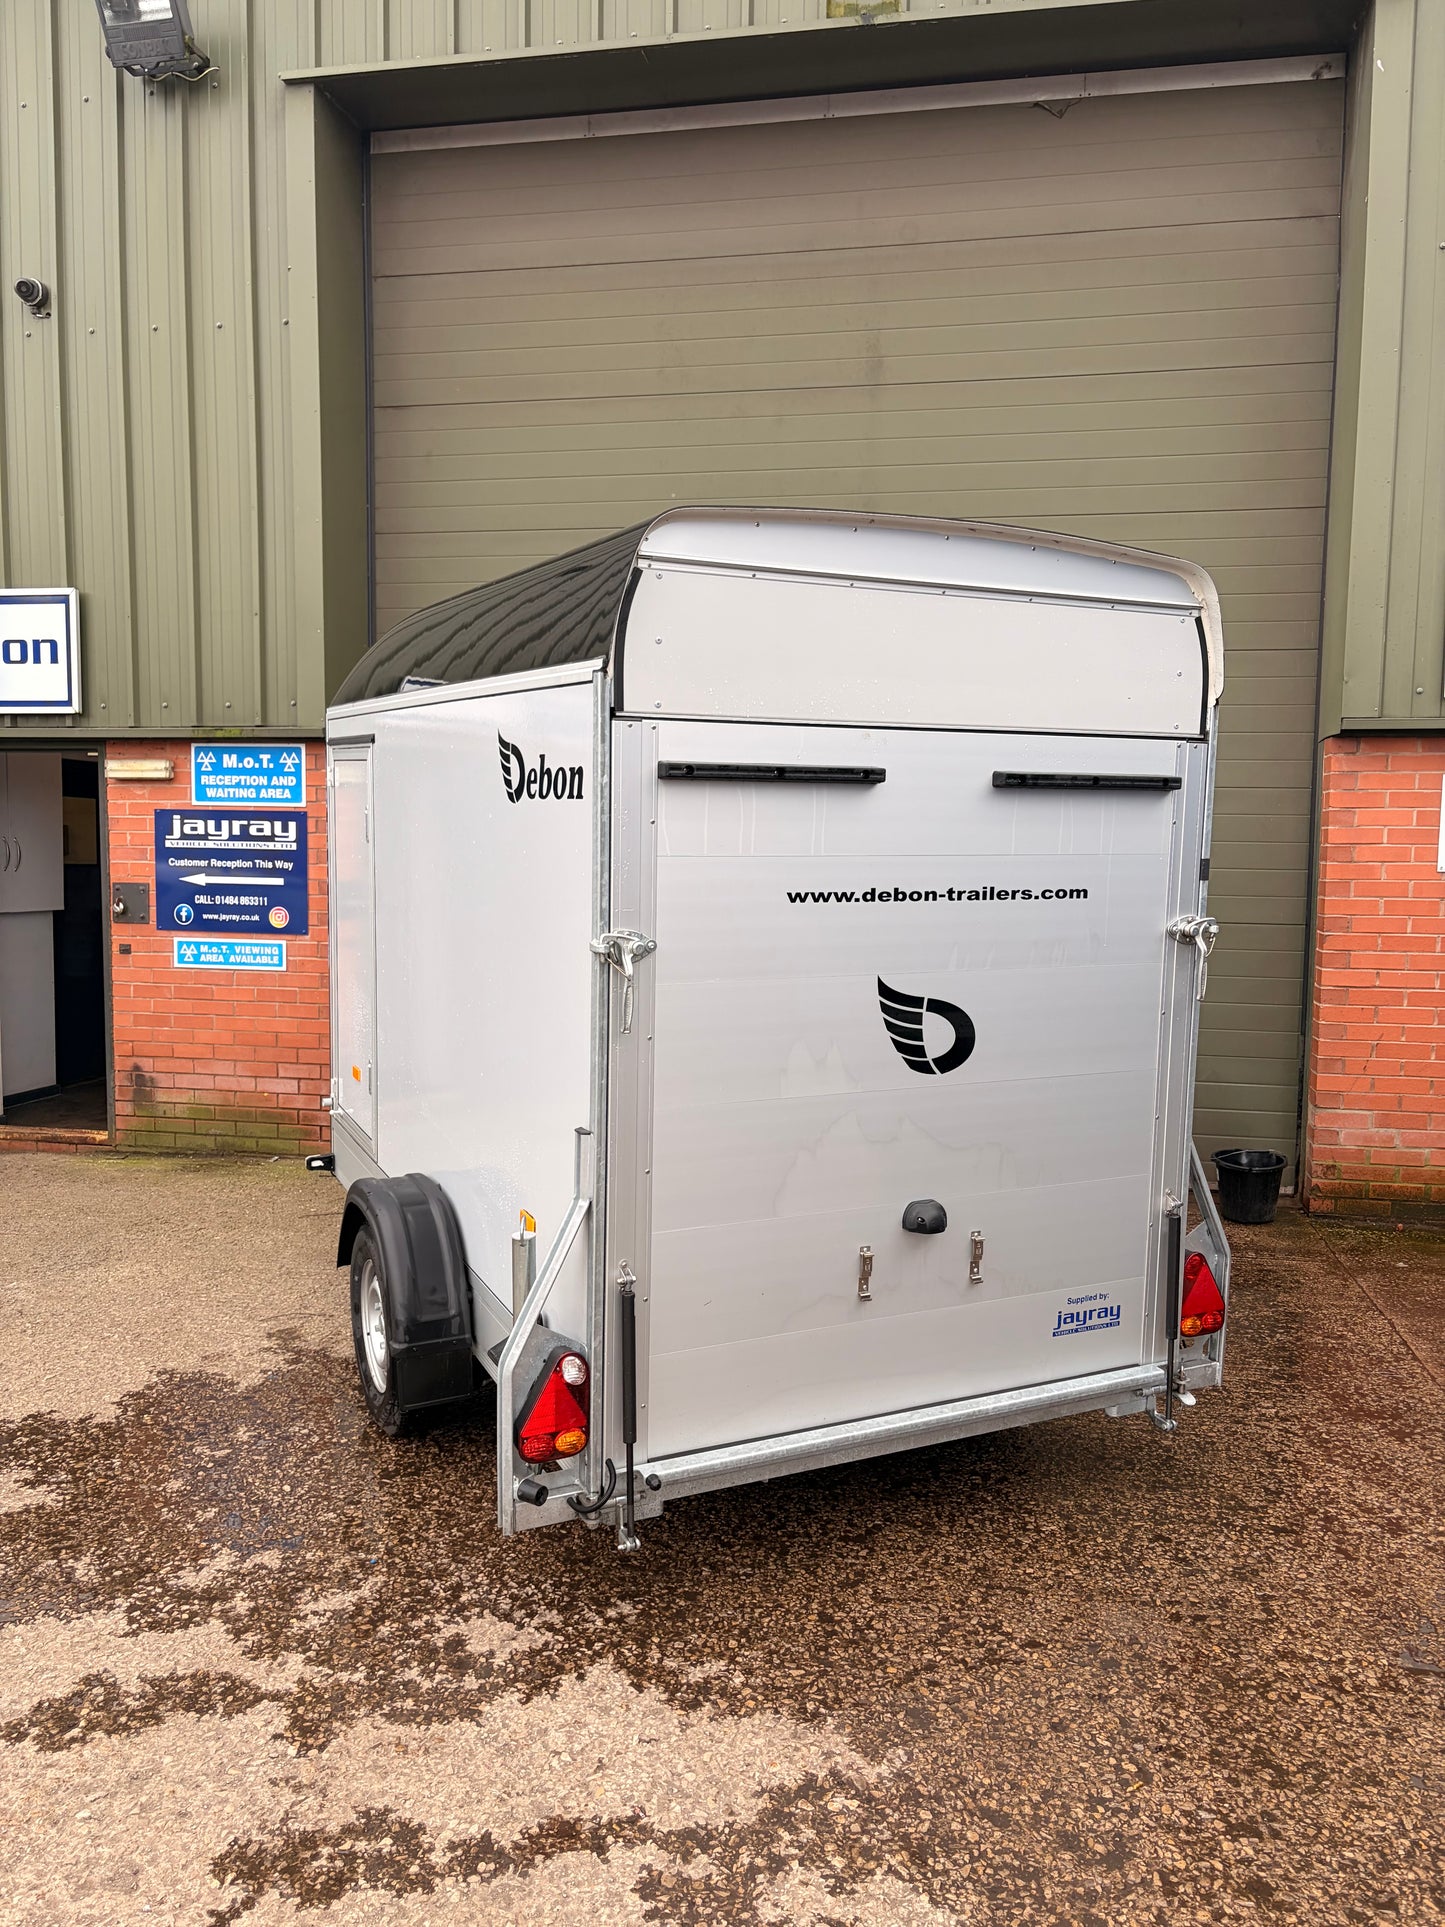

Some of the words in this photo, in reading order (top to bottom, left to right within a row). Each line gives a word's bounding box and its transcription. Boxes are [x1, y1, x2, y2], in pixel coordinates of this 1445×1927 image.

[222, 754, 274, 768] M.o.T.
[497, 728, 584, 804] Debon
[201, 775, 268, 785] RECEPTION
[270, 776, 297, 787] AND
[205, 788, 257, 798] WAITING
[259, 789, 292, 799] AREA
[165, 814, 297, 842] jayray
[168, 858, 209, 867] Customer
[210, 859, 252, 869] Reception
[254, 860, 273, 869] This
[274, 860, 293, 871] Way
[194, 895, 214, 905] CALL:
[215, 895, 239, 905] 01484
[240, 896, 268, 906] 863311
[786, 886, 1089, 903] www.debon-trailers.com
[202, 912, 260, 922] www.jayray.co.uk
[200, 945, 230, 954] M.o.T.
[234, 945, 279, 955] VIEWING
[200, 954, 225, 963] AREA
[229, 954, 279, 964] AVAILABLE
[1067, 1294, 1097, 1304] Supplied
[1099, 1292, 1110, 1301] by:
[1053, 1305, 1121, 1330] jayray
